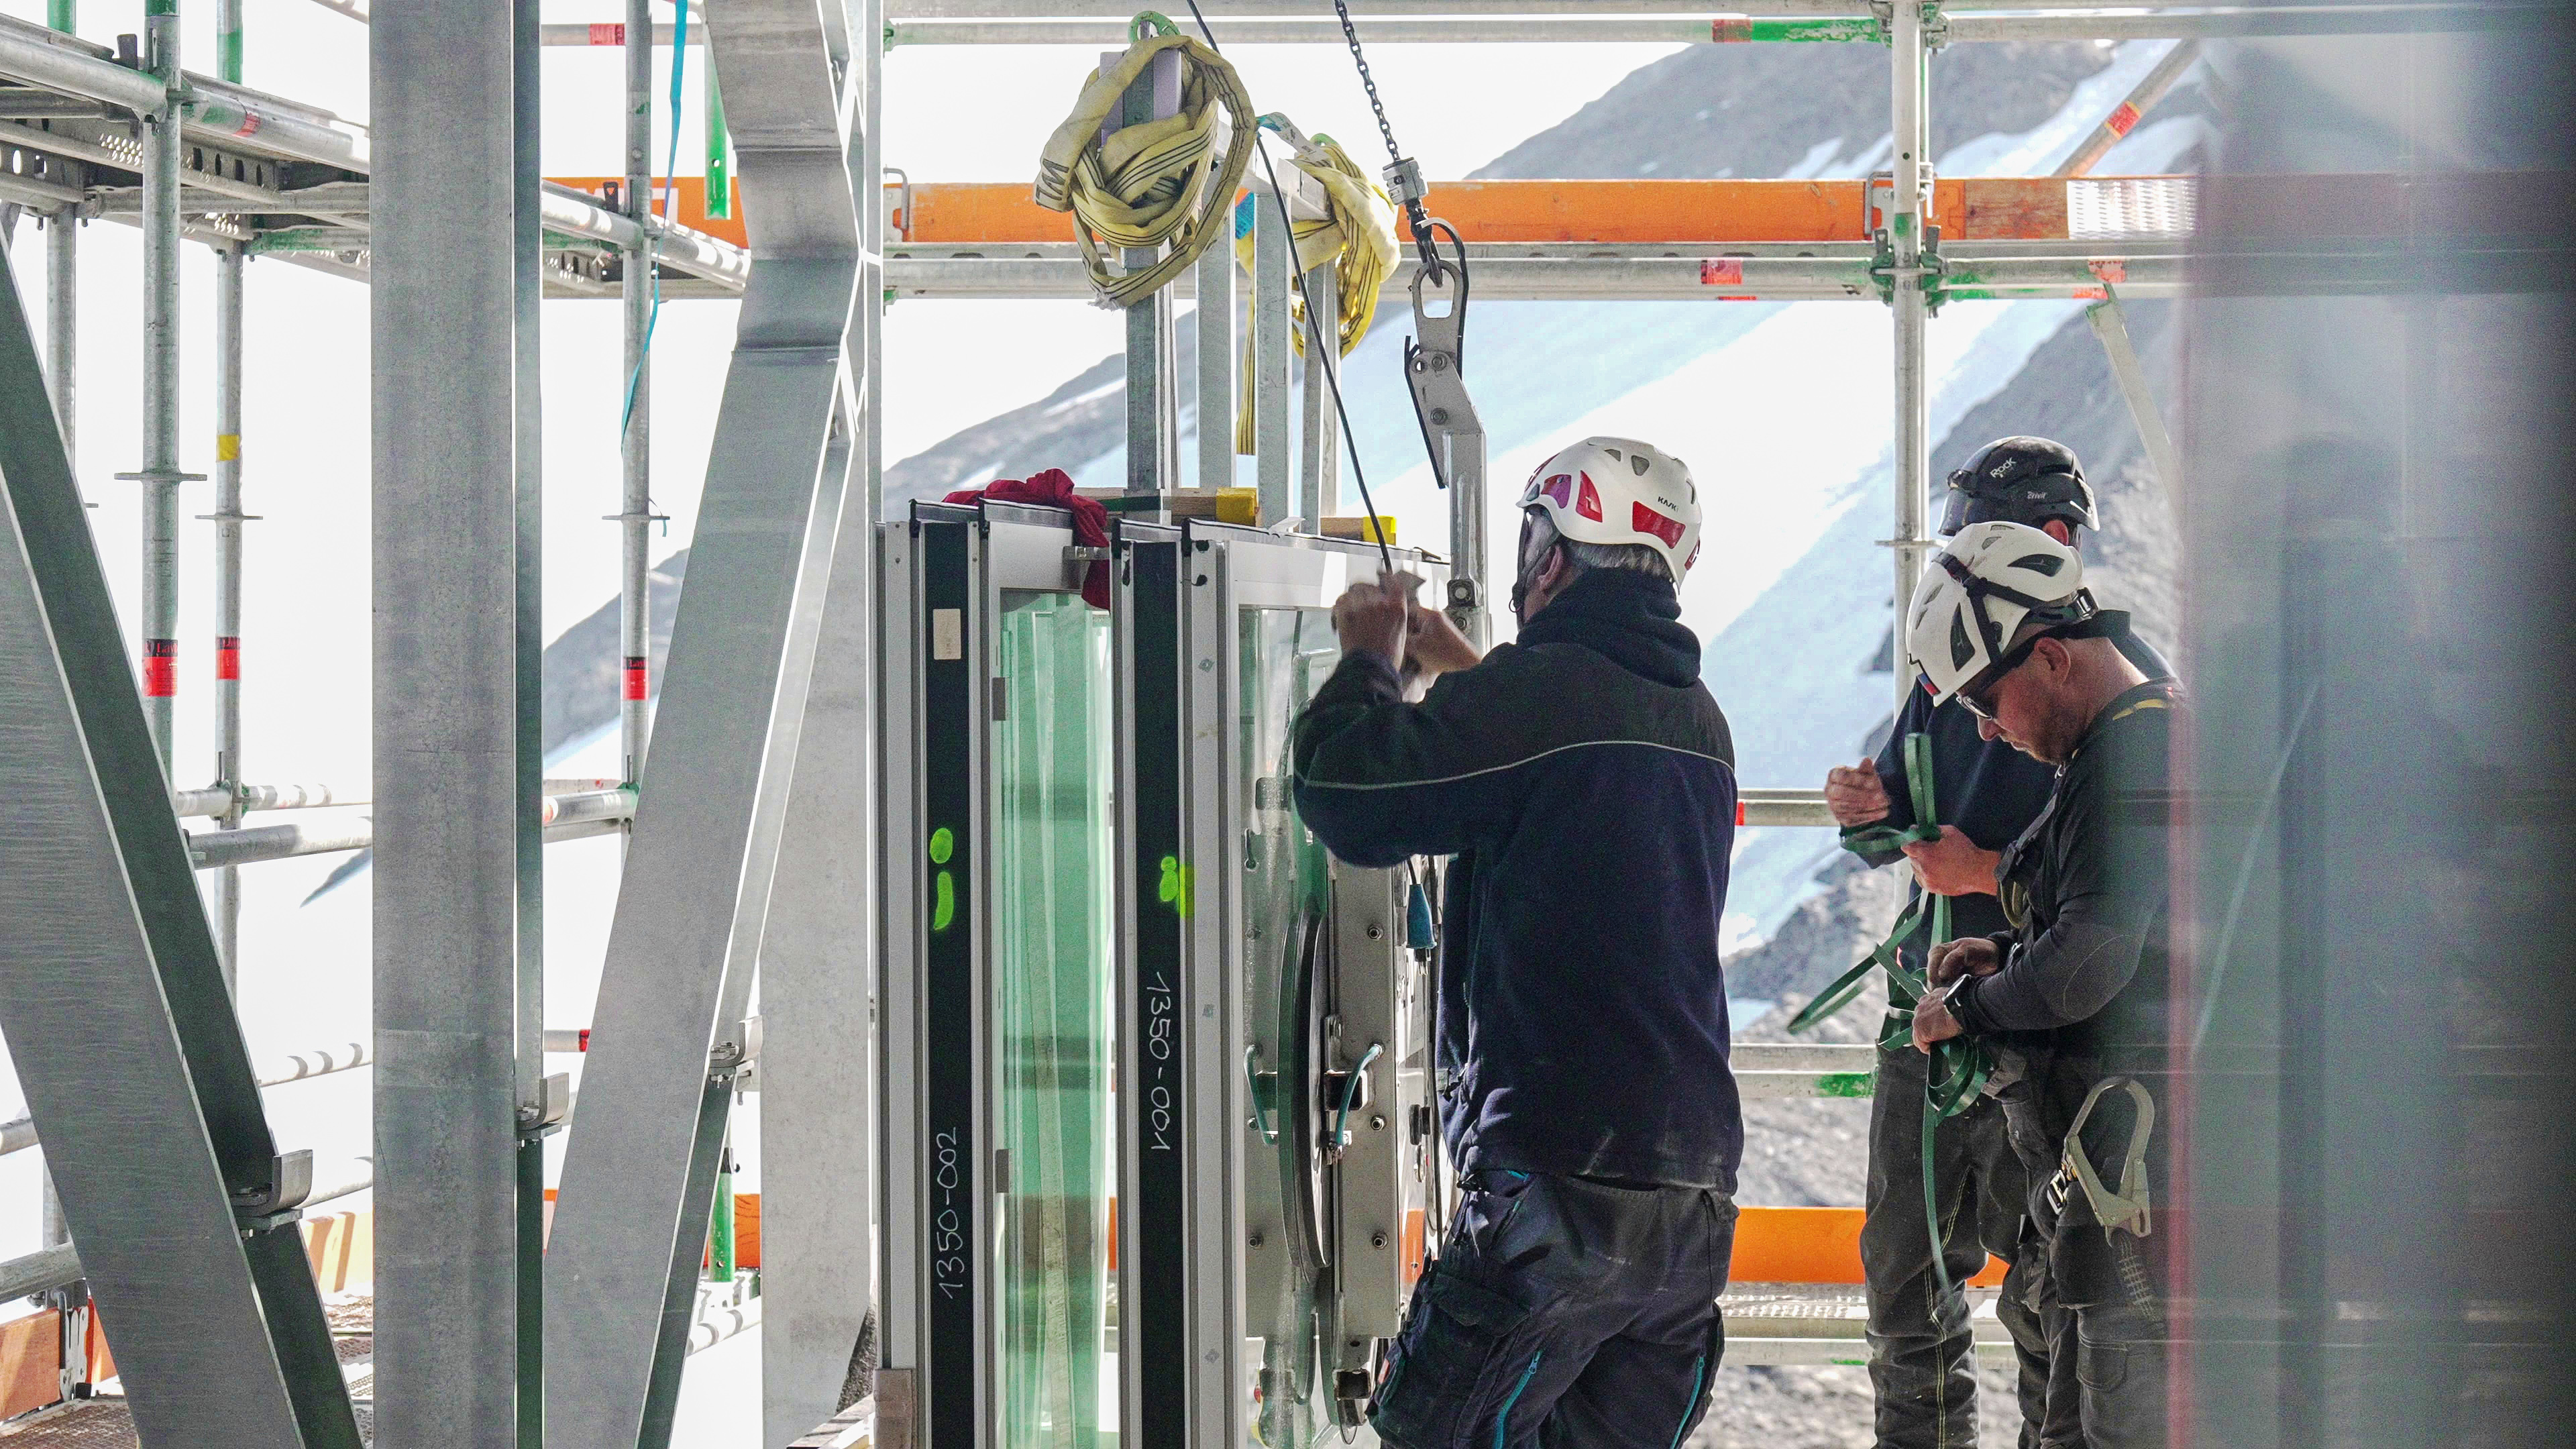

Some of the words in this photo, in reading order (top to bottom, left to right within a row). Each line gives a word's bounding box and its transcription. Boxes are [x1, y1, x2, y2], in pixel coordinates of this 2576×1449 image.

[1658, 496, 1676, 511] KASK
[1146, 971, 1171, 1150] 1350-001
[936, 1127, 965, 1299] 1350-002
